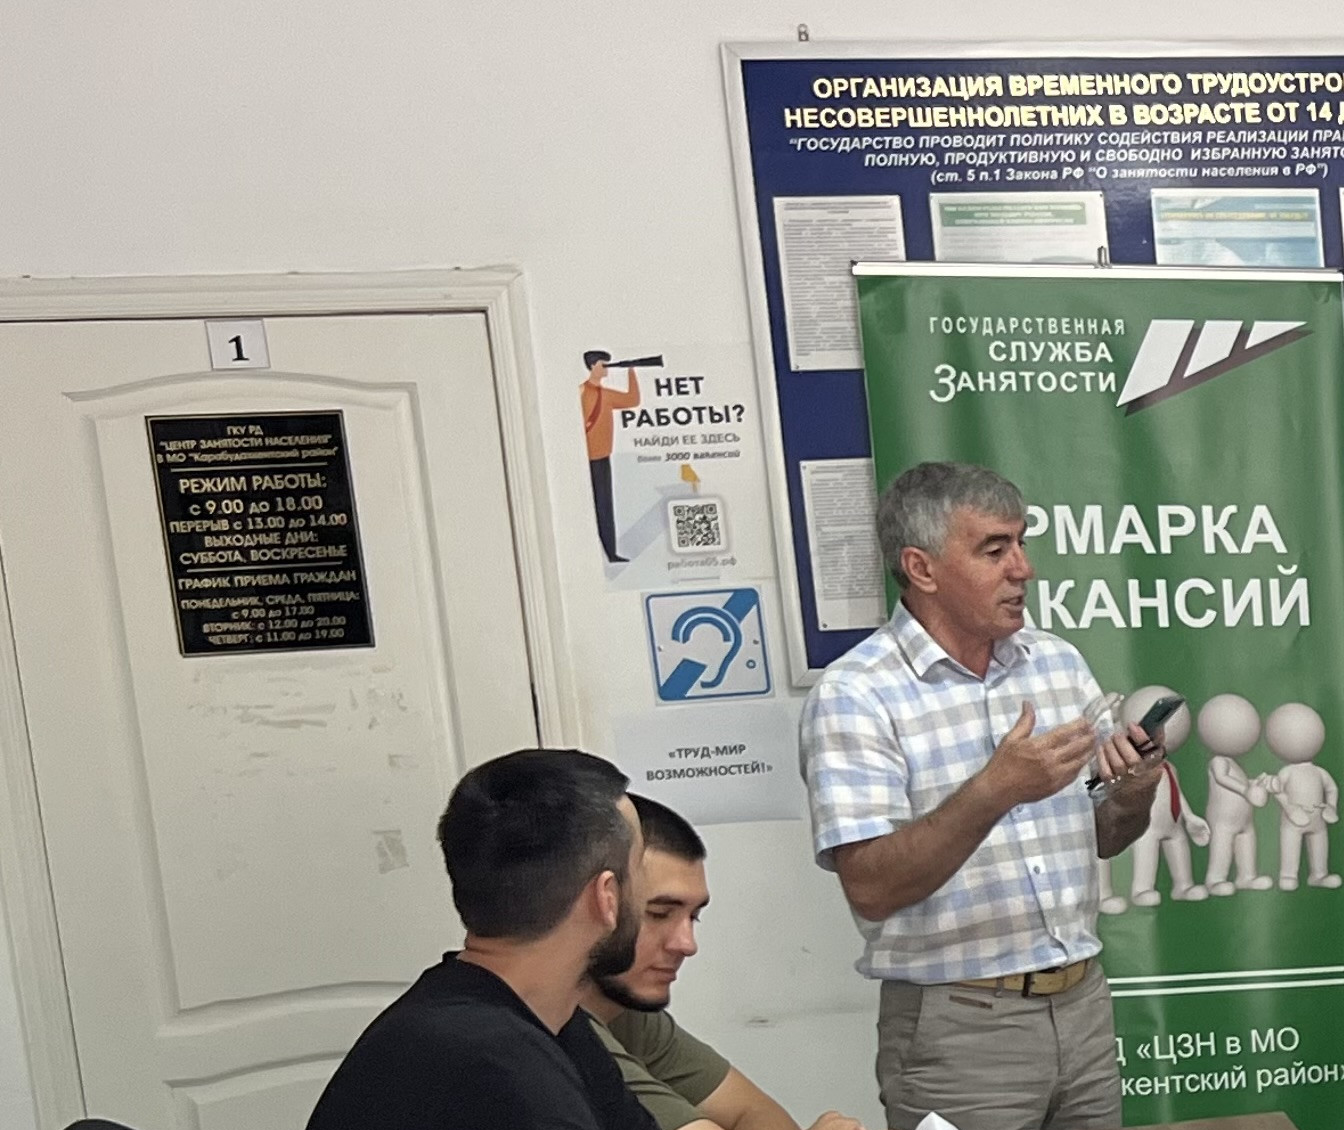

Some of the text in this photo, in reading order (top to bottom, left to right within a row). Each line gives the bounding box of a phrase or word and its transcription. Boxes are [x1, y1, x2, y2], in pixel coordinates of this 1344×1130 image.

[813, 75, 1003, 100] ОРГАНИЗАЦИЯ
[1008, 73, 1182, 96] ВРЕМЕННОГО
[784, 104, 1104, 129] НЕСОВЕРШЕННОЛЕТНИХ
[1109, 104, 1127, 125] В
[1133, 103, 1262, 125] ВОЗРАСТЕ
[1267, 102, 1299, 123] ОТ
[1307, 103, 1332, 121] 14
[919, 134, 1006, 149] ПРОВОДИТ
[1010, 132, 1093, 147] ПОЛИТИКУ
[1097, 129, 1201, 147] СОДЕЙСТВИЯ
[1207, 130, 1309, 144] РЕАЛИЗАЦИИ
[864, 152, 940, 168] ПОЛНУЮ,
[944, 150, 1076, 167] ПРОДУКТИВНУЮ
[1080, 149, 1092, 162] И
[1095, 147, 1183, 163] СВОБОДНО
[1191, 147, 1287, 161] ИЗБРАННУЮ
[931, 169, 962, 185] (ст.
[967, 168, 976, 181] 5
[979, 168, 1001, 182] п.1
[1006, 168, 1058, 181] Закона
[1062, 167, 1084, 180] РФ
[1112, 166, 1197, 179] занятости
[1202, 164, 1278, 178] населения
[929, 317, 1125, 336] ГОСУДАРСТВЕННАЯ
[229, 335, 250, 361] 1
[989, 341, 1114, 363] СЛУЖБА
[655, 376, 704, 396] НЕТ
[621, 404, 745, 428] РАБОТЫ?
[200, 438, 262, 449] ЗАНЯТОСТИ
[634, 432, 740, 447] НАЙДИ ЕЕ ЗДЕСЬ
[166, 453, 186, 463] МО
[179, 473, 327, 494] РЕЖИМ РАБОТЫ:
[206, 499, 244, 515] 9.00
[276, 495, 323, 512] 18.00
[170, 519, 229, 533] ПЕРЕРЫВ
[248, 516, 285, 530] 13.00
[310, 513, 347, 527] 14.00
[1024, 504, 1288, 555] РМАРКА
[204, 531, 319, 548] ВЫХОДНЫЕ ДНИ:
[251, 545, 347, 562] ВОСКРЕСЕНЬЕ
[178, 569, 357, 590] ГРАФИК ПРИЕМА ГРАЖДАН
[1023, 564, 1311, 629] КАНСИЙ
[669, 744, 746, 759] «ТРУД-МИР
[646, 761, 773, 781] ВОЗМОЖНОСТЕЙ!»
[1136, 1032, 1216, 1065] «ЦЗН
[1226, 1036, 1242, 1055] в
[1251, 1026, 1300, 1053] МО
[1121, 1065, 1247, 1097] кентский
